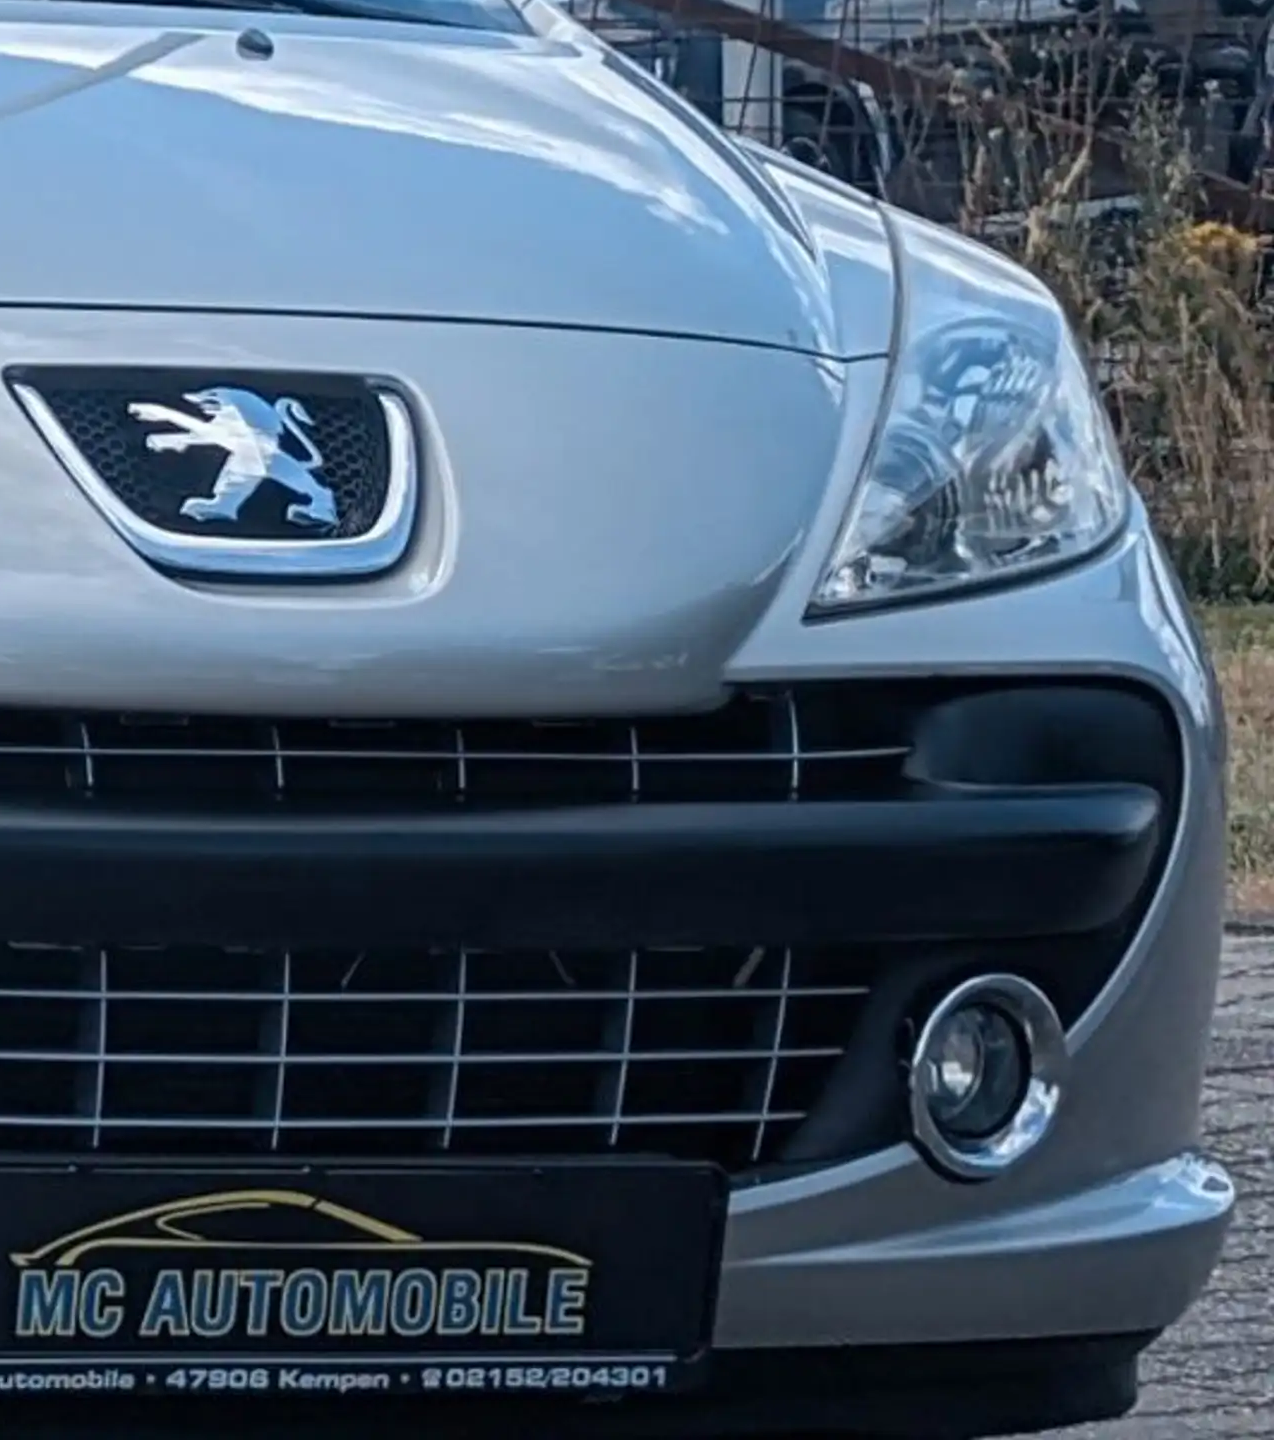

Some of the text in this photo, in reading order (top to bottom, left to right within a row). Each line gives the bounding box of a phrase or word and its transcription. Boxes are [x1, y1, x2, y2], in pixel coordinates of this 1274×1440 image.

[15, 1268, 592, 1338] MC AUTOMOBILE
[277, 1368, 391, 1394] Kempen
